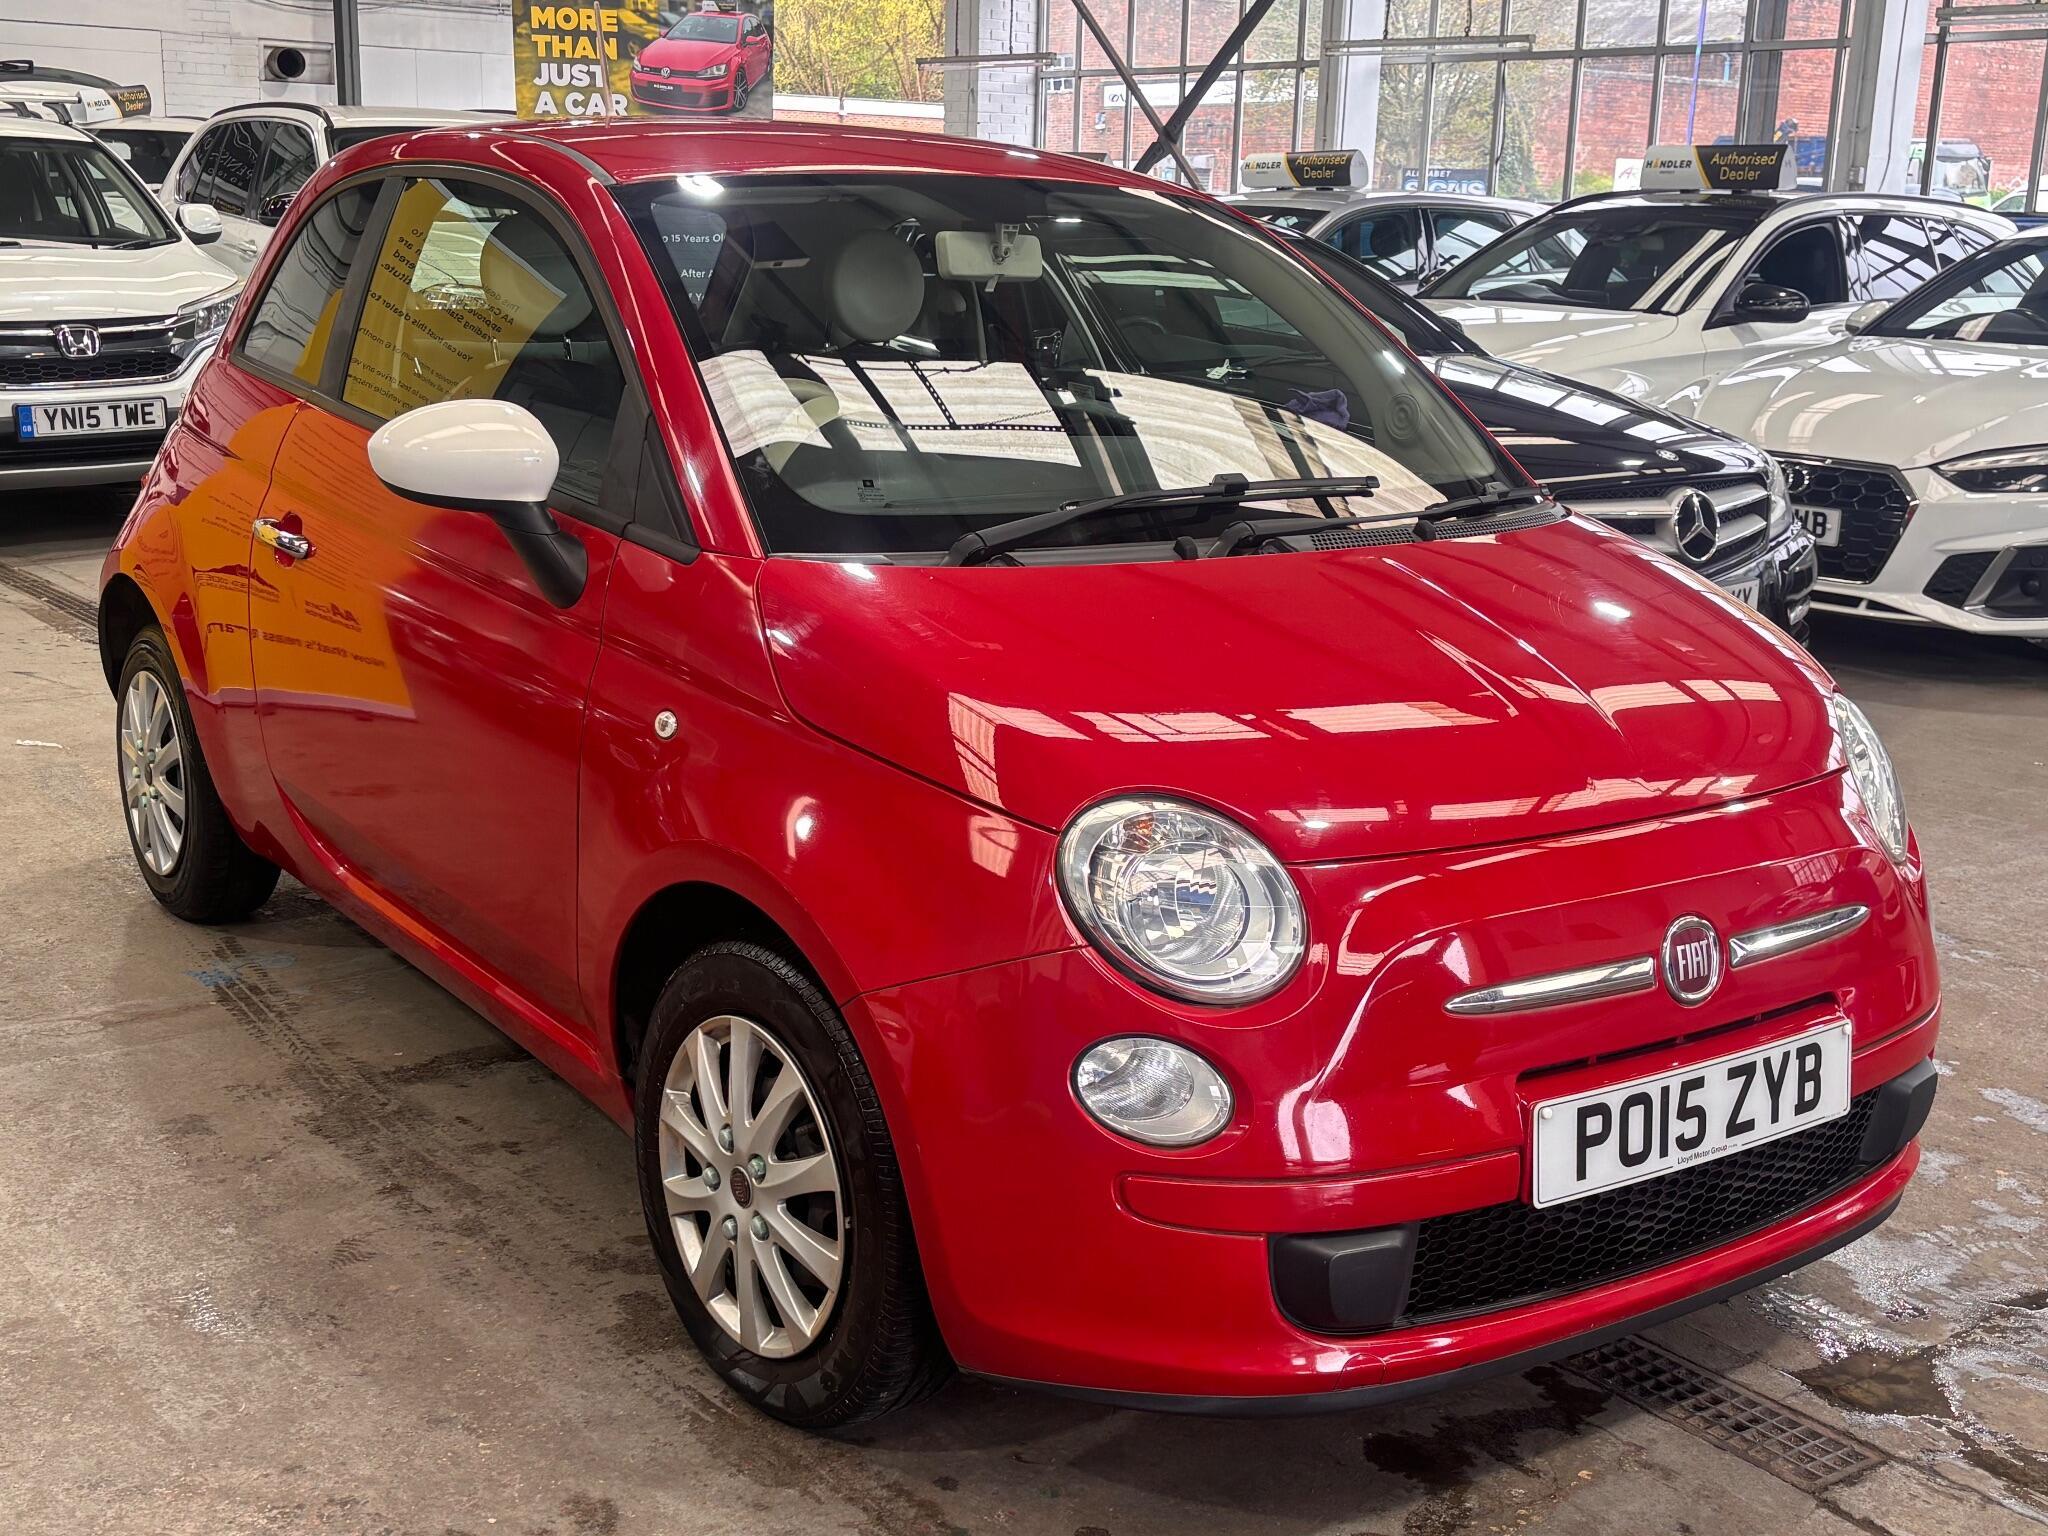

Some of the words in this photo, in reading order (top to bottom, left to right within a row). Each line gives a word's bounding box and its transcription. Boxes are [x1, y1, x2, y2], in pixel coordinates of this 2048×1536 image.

[530, 6, 618, 32] MORE
[531, 34, 617, 60] THAN
[533, 63, 604, 88] JUST
[117, 89, 148, 101] Authorised
[534, 91, 558, 115] A
[564, 92, 628, 116] CAR
[125, 102, 144, 111] Dealer
[1295, 154, 1348, 165] Authorised
[1710, 152, 1778, 165] Authorised
[1303, 166, 1336, 179] Dealer
[1719, 167, 1760, 181] Dealer
[1405, 181, 1486, 195] SGNS
[671, 234, 681, 242] 15
[683, 234, 710, 243] Years
[713, 233, 726, 243] Ol
[681, 269, 706, 278] After
[43, 406, 101, 431] YN15
[108, 403, 156, 427] TWE
[1795, 509, 1827, 538] WB
[1676, 939, 1708, 981] FIAT
[1576, 1075, 1707, 1182] PO15
[1725, 1042, 1823, 1139] ZYB
[1677, 1154, 1694, 1164] Lloyd
[1694, 1149, 1711, 1159] Motor
[1711, 1144, 1728, 1154] Group
